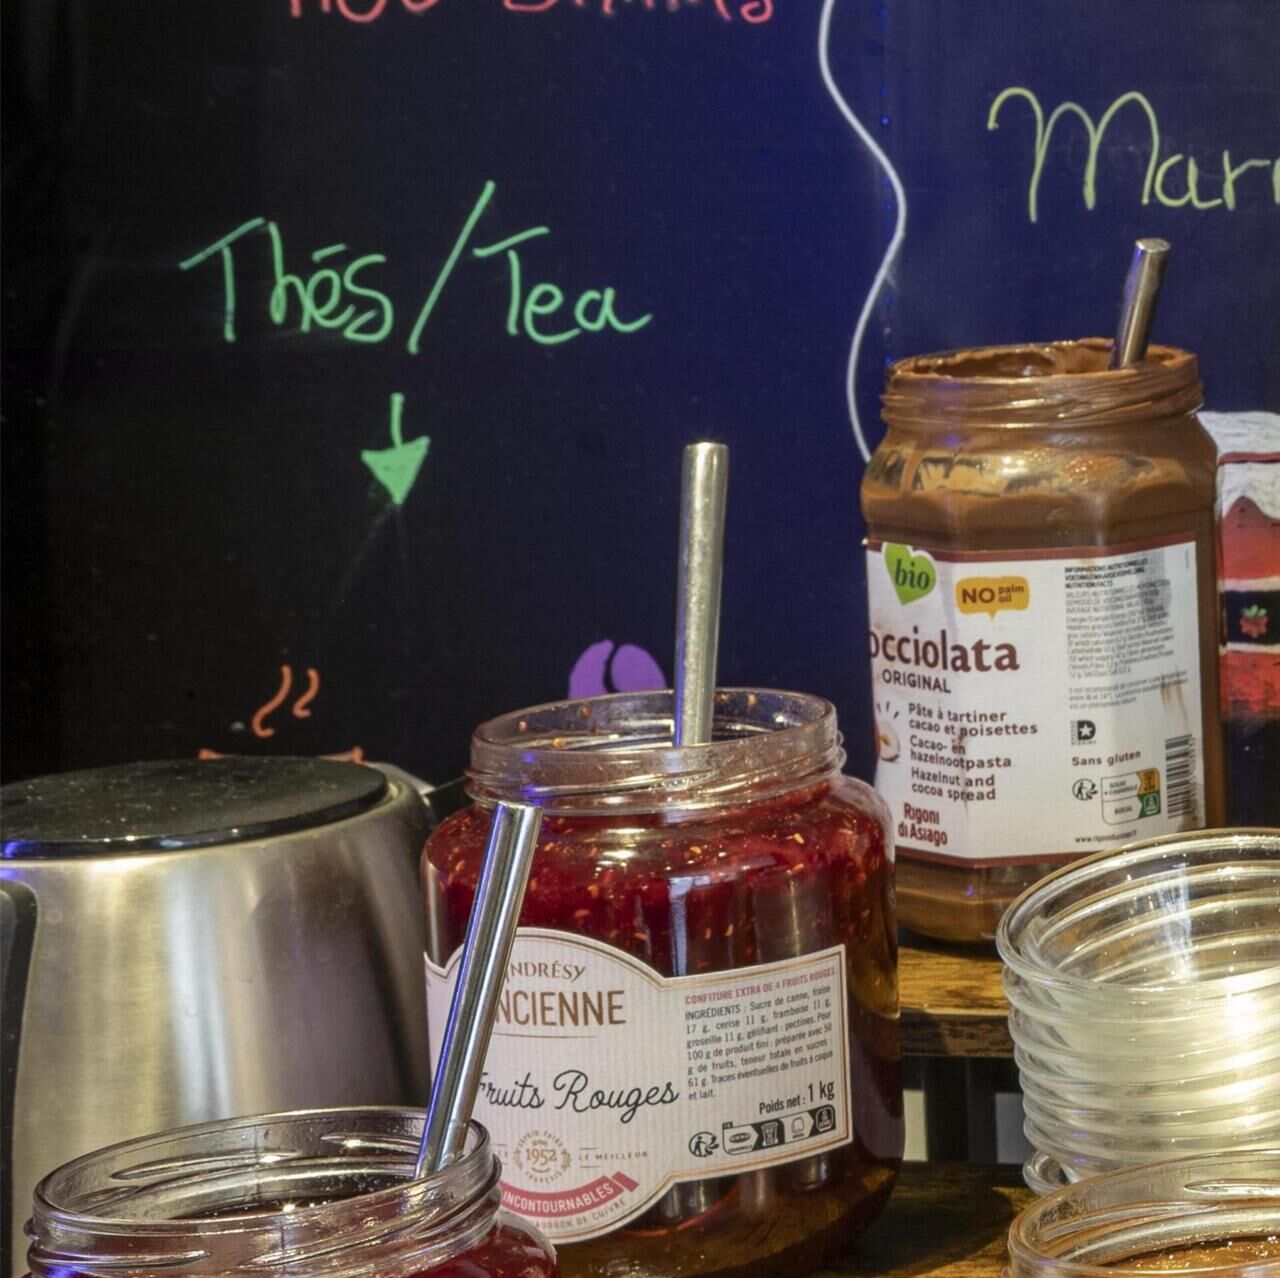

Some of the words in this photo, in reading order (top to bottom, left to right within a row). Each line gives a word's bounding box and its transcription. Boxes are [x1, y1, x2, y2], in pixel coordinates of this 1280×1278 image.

[895, 558, 930, 590] bio
[962, 588, 995, 604] NO
[999, 584, 1024, 594] palm
[870, 626, 1020, 672] occiolata
[882, 669, 951, 693] ORIGINAL
[908, 702, 933, 718] Pâte
[938, 706, 943, 720] à
[948, 710, 1007, 723] tartiner
[909, 719, 940, 732] cacao
[944, 724, 956, 734] et
[960, 724, 1038, 736] noisettes
[910, 749, 1012, 771] hazelnootpasta
[1072, 757, 1102, 766] Sans
[1107, 751, 1141, 766] gluten
[912, 766, 960, 786] Hazelnut
[965, 774, 995, 787] and
[912, 782, 942, 796] cocoa
[948, 788, 996, 802] spread
[904, 802, 939, 824] Rigoni
[898, 822, 908, 837] di
[910, 824, 948, 846] Asiago
[506, 960, 587, 983] NDRÉSY
[685, 990, 732, 1005] CONFITURE
[736, 985, 761, 998] EXTRA
[763, 983, 773, 993] DE
[775, 982, 780, 990] 4
[782, 974, 809, 989] FRUITS
[810, 967, 835, 981] ROUGES
[496, 990, 626, 1027] NCIENNE
[553, 1069, 680, 1124] Rouges
[759, 1099, 784, 1115] Poids
[787, 1095, 800, 1109] net
[808, 1083, 813, 1102] 1
[819, 1080, 835, 1100] kg
[526, 1148, 557, 1166] 1952
[503, 1182, 614, 1213] INCONTOURNABLES
